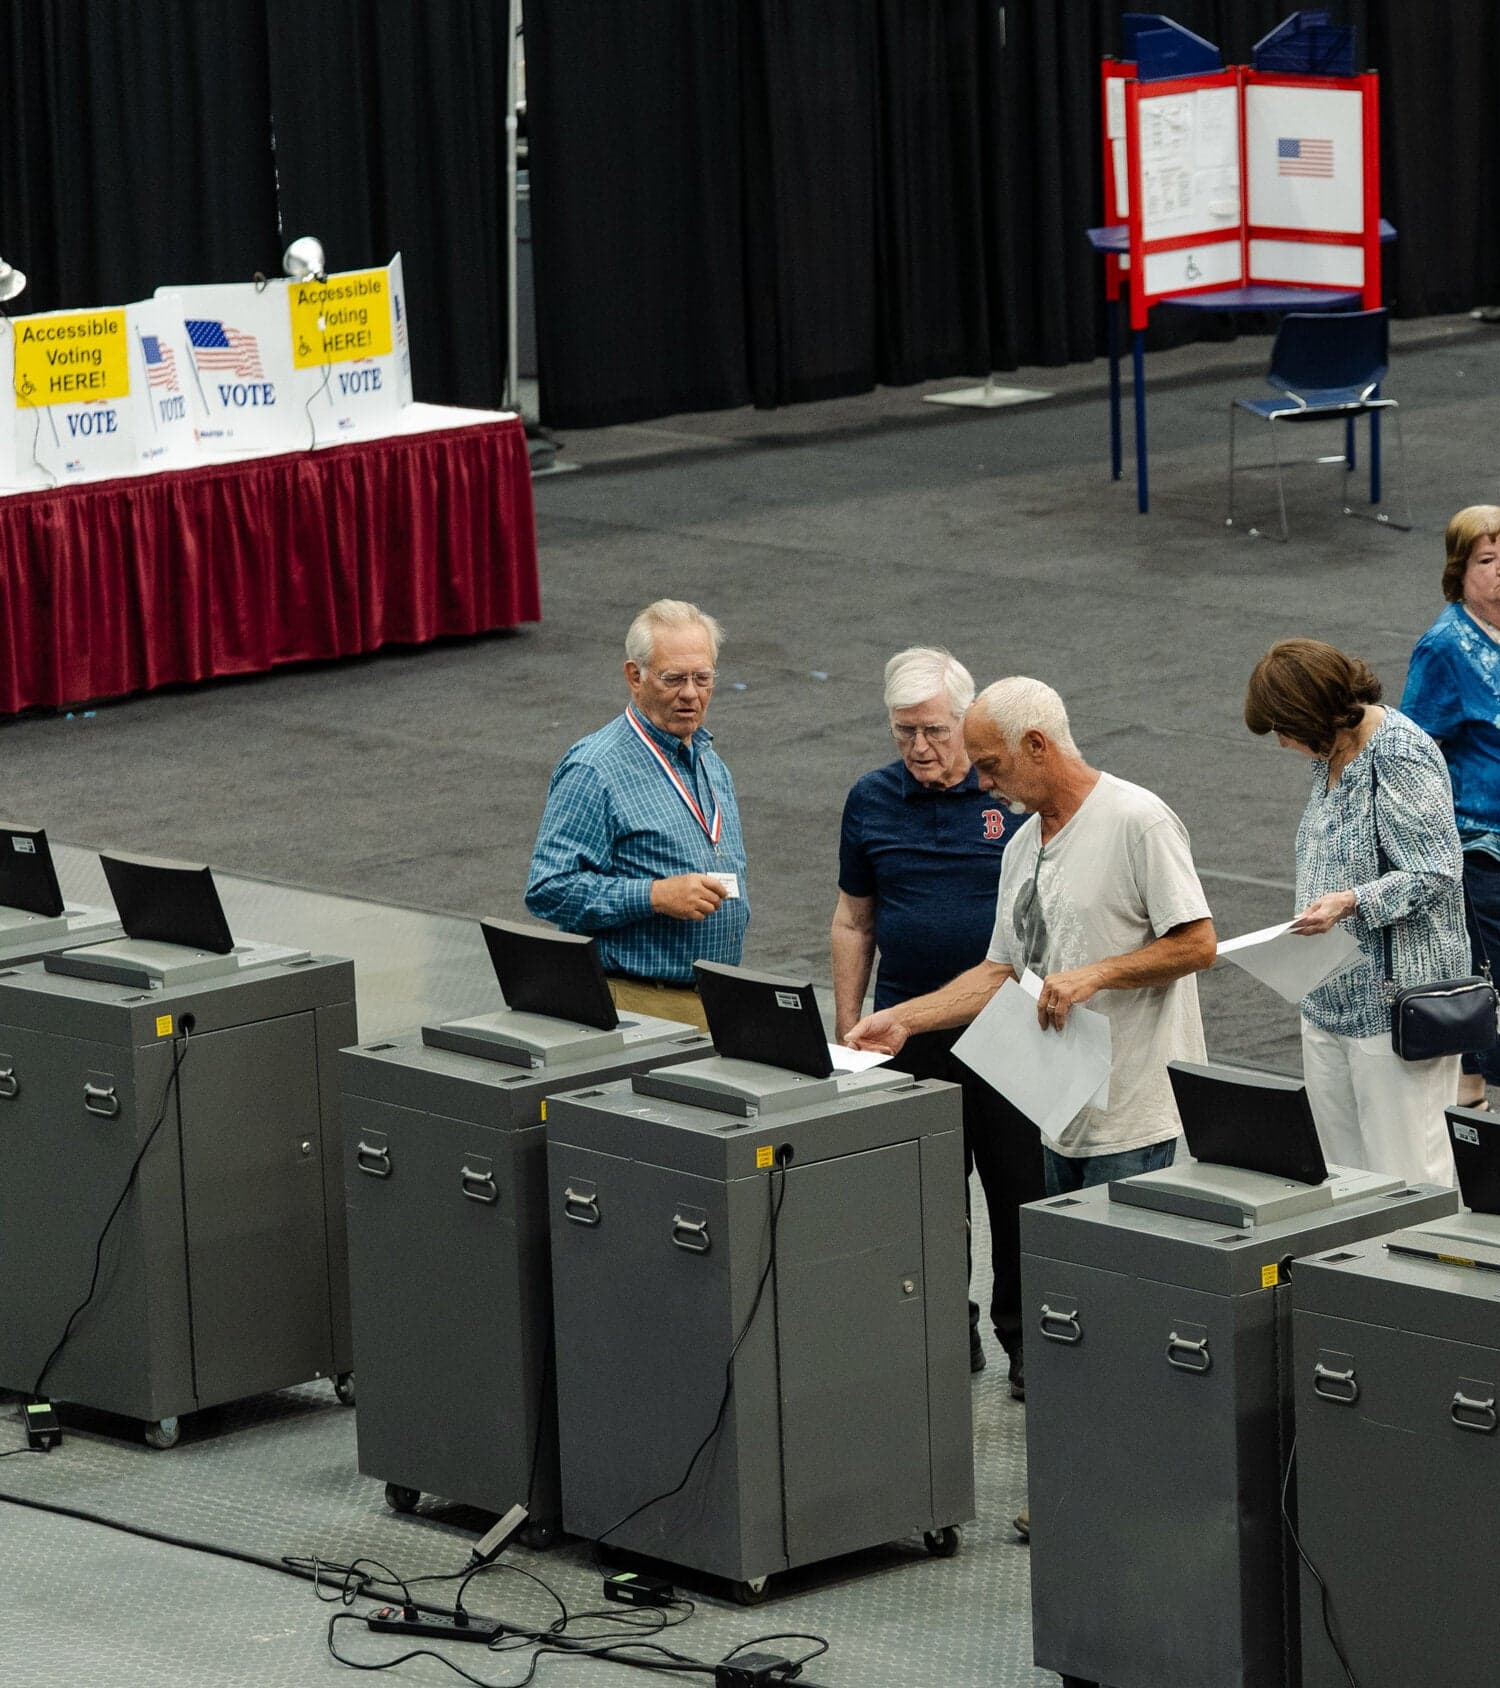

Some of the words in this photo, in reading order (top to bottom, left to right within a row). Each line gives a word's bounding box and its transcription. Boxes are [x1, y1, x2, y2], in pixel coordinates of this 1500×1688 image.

[297, 279, 382, 306] Accessible
[22, 319, 118, 343] Accessible
[323, 331, 372, 353] HERE!
[46, 347, 102, 366] Voting
[49, 371, 107, 393] HERE!
[339, 368, 383, 395] VOTE
[218, 383, 276, 407] VOTE
[160, 395, 186, 423] VOTE
[67, 410, 118, 437] VOTE
[981, 808, 1006, 840] B
